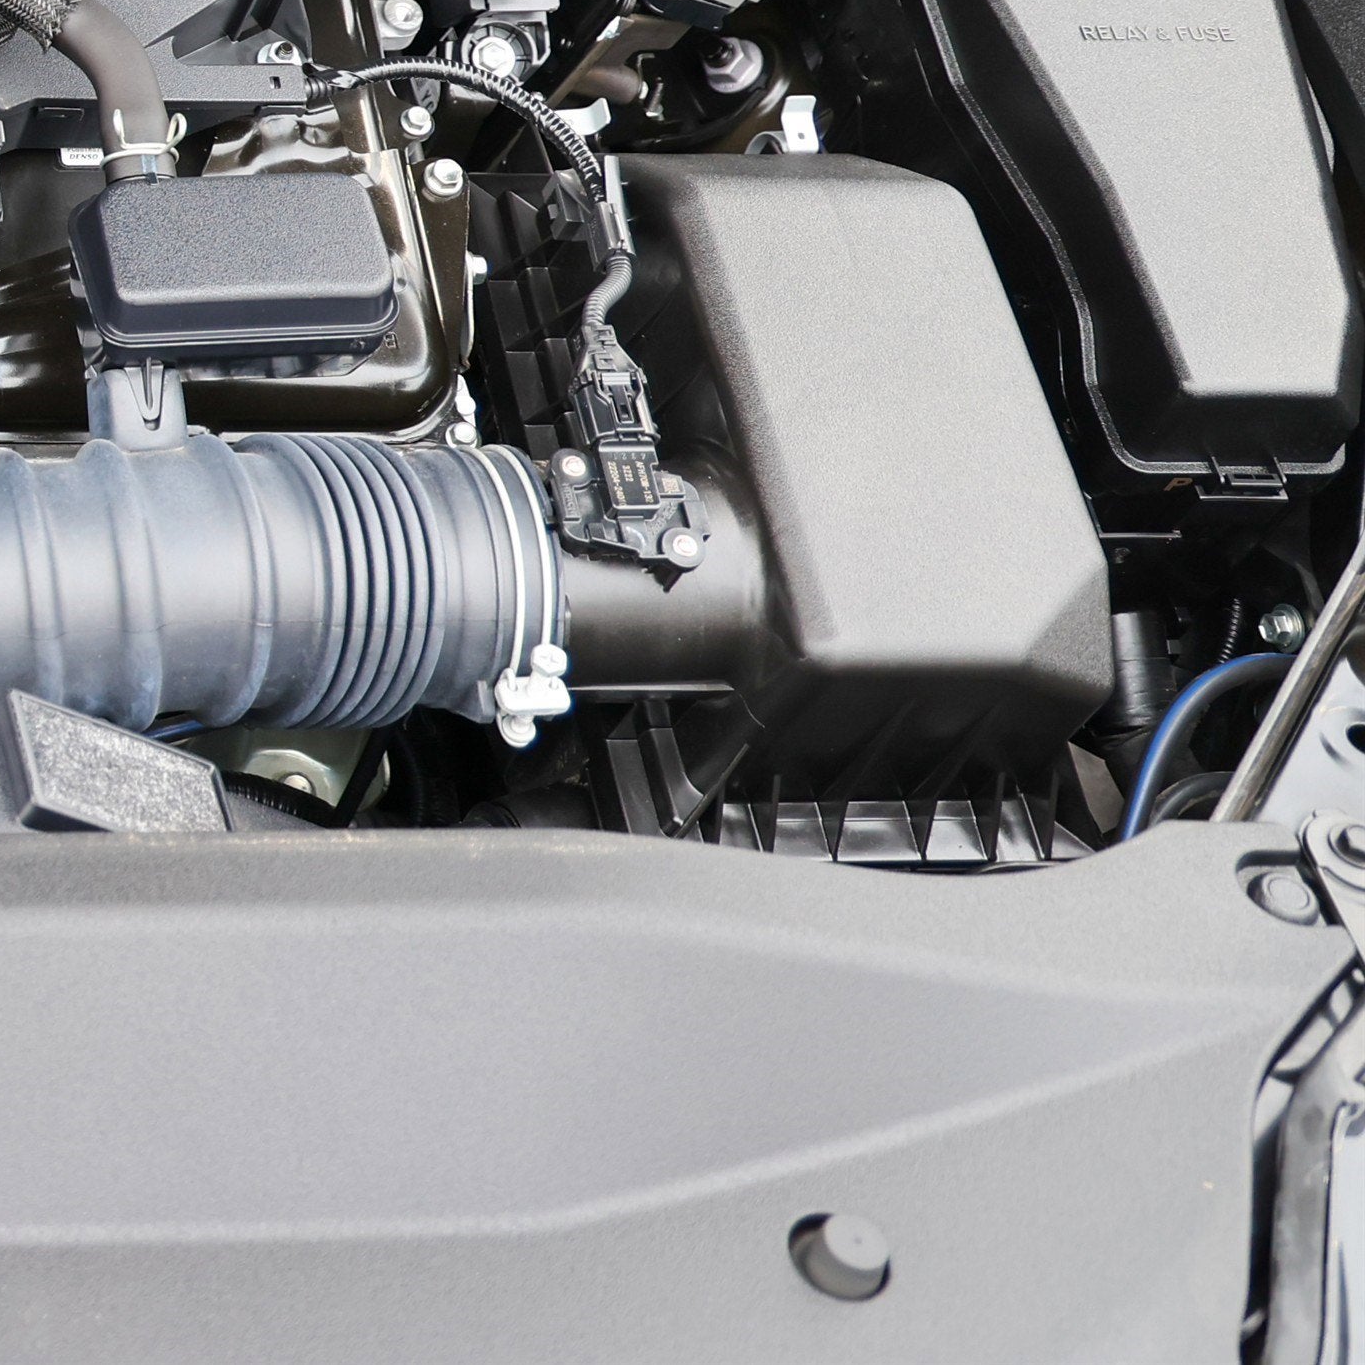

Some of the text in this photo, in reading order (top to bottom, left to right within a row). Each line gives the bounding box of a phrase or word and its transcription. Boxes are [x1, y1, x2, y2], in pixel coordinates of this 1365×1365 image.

[1079, 25, 1236, 42] RELAY & FUSE
